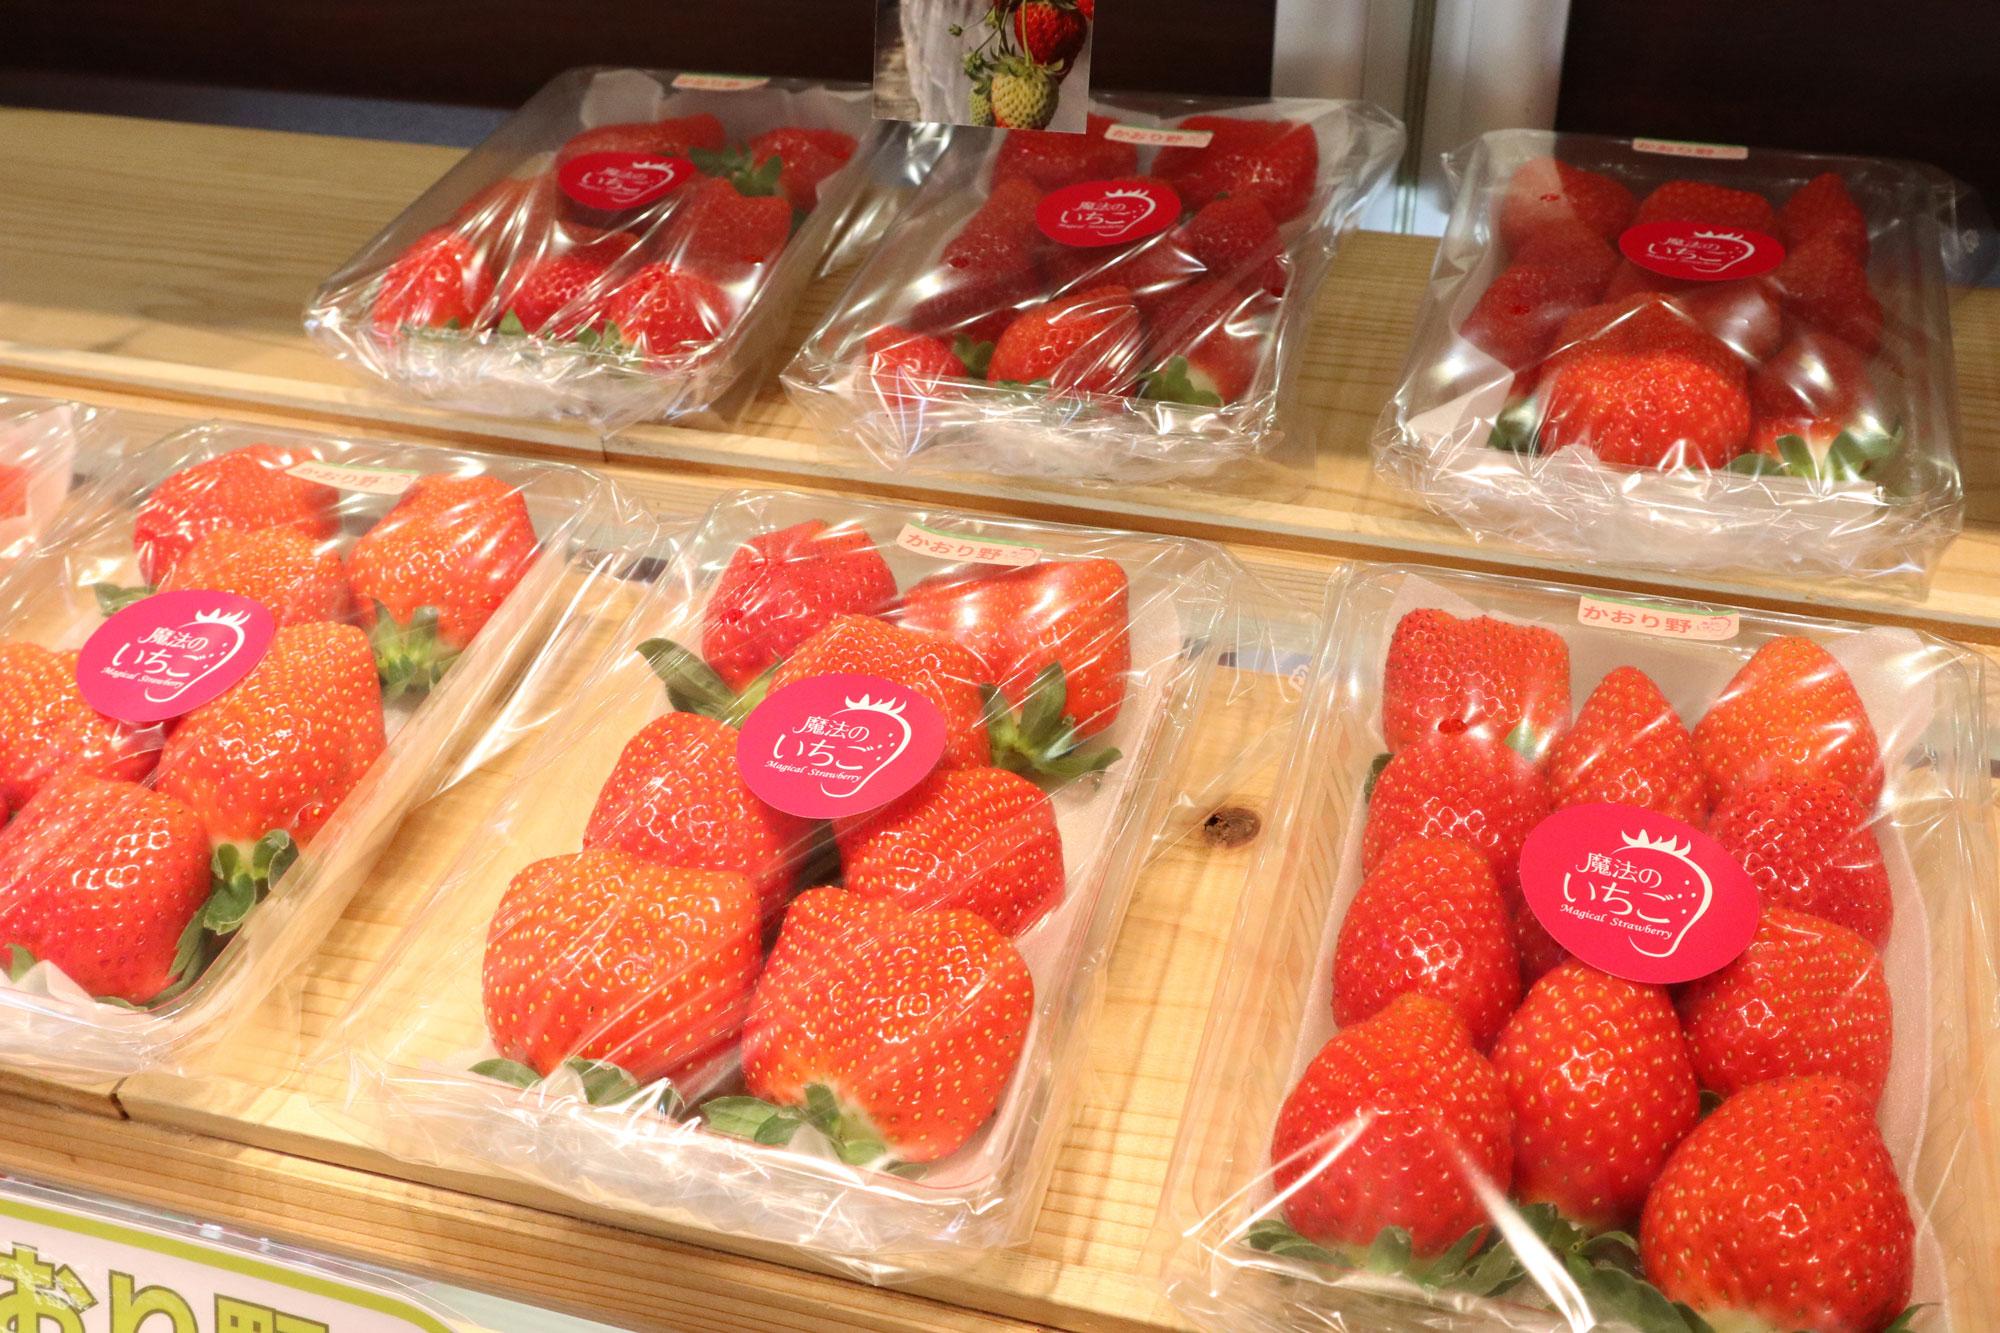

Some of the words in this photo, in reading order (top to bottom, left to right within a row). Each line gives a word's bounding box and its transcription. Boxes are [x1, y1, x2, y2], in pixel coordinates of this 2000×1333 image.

[905, 533, 1004, 561] かおり野
[1583, 605, 1692, 634] かおり野
[137, 626, 209, 650] 魔法の
[111, 642, 207, 678] いちご
[792, 715, 870, 743] 魔法の
[773, 733, 874, 771] いちご
[764, 759, 807, 774] Magical
[807, 768, 862, 783] Strawberry
[1575, 852, 1662, 889] 魔法の
[1563, 872, 1675, 924] いちご
[1560, 903, 1608, 923] Magical
[1609, 917, 1673, 940] Strawberry
